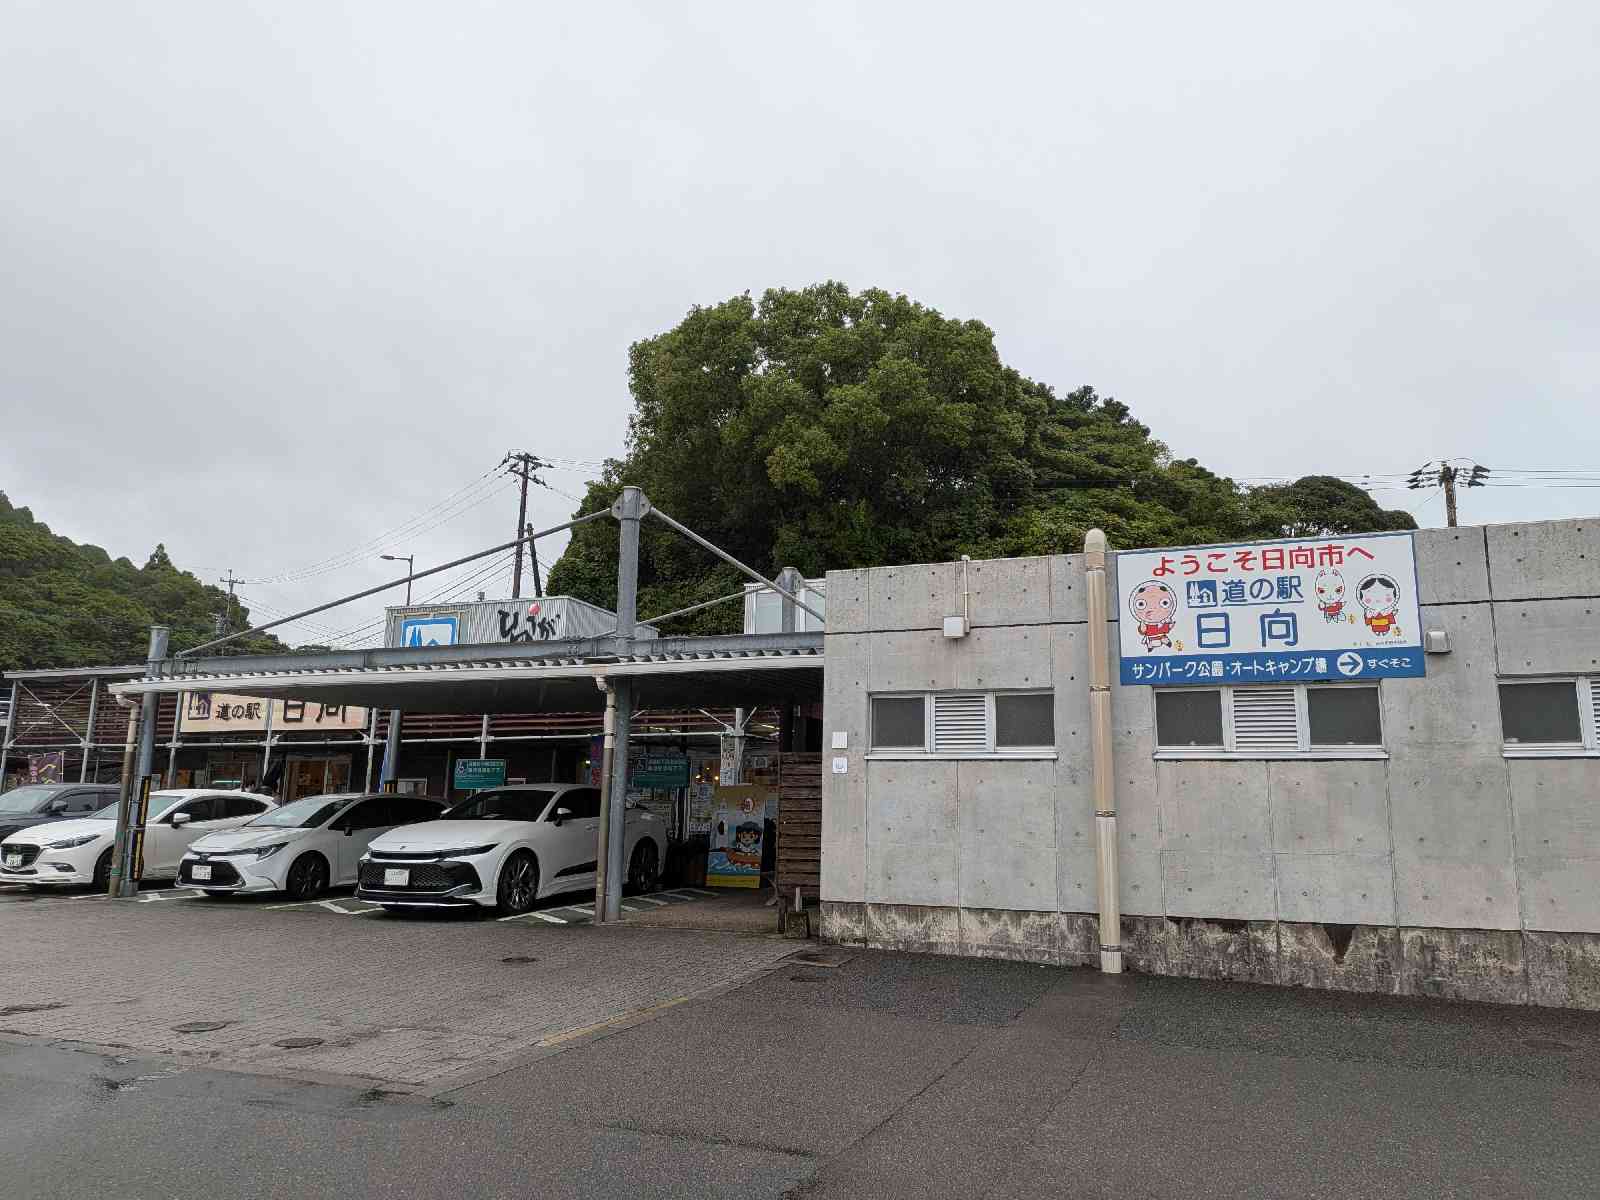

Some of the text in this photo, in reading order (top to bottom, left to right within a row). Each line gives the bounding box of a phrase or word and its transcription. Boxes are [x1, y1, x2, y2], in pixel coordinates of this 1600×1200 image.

[1153, 544, 1375, 576] ようこそ日向市へ
[1222, 576, 1304, 603] 道の駅
[1197, 608, 1299, 648] 日向
[1367, 657, 1412, 669] すぐそこ
[216, 703, 261, 720] 道の駅
